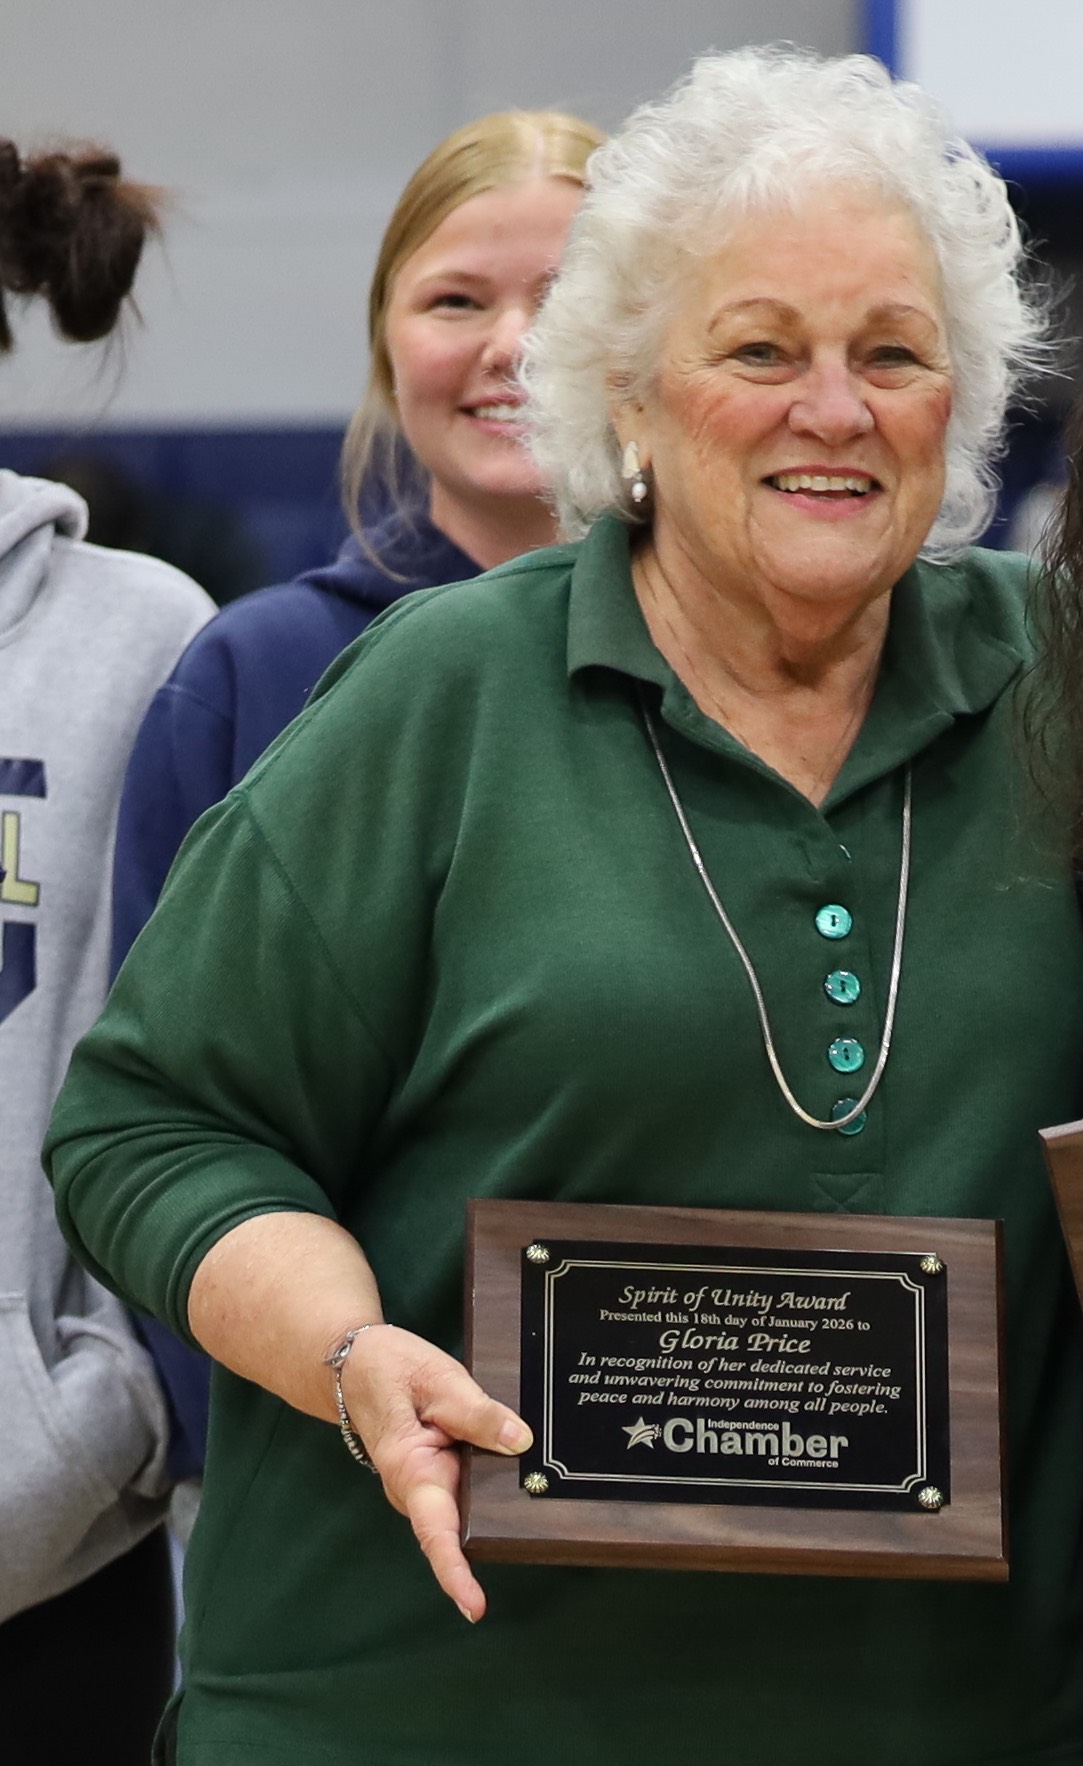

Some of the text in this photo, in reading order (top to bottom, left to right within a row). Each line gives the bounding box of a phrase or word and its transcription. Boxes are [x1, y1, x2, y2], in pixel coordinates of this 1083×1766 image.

[618, 1285, 851, 1315] Spirit of Unity Award
[599, 1309, 871, 1331] Presented this 18th day of January 2026 to
[659, 1327, 811, 1354] Gloria Price
[577, 1352, 891, 1378] In recognition of her dedicated service
[568, 1370, 902, 1399] and unwavering commitment to fostering
[577, 1391, 888, 1416] peace and harmony among all people.
[707, 1418, 780, 1431] Independence
[663, 1417, 849, 1459] Chamber
[768, 1456, 839, 1469] of Commerce
